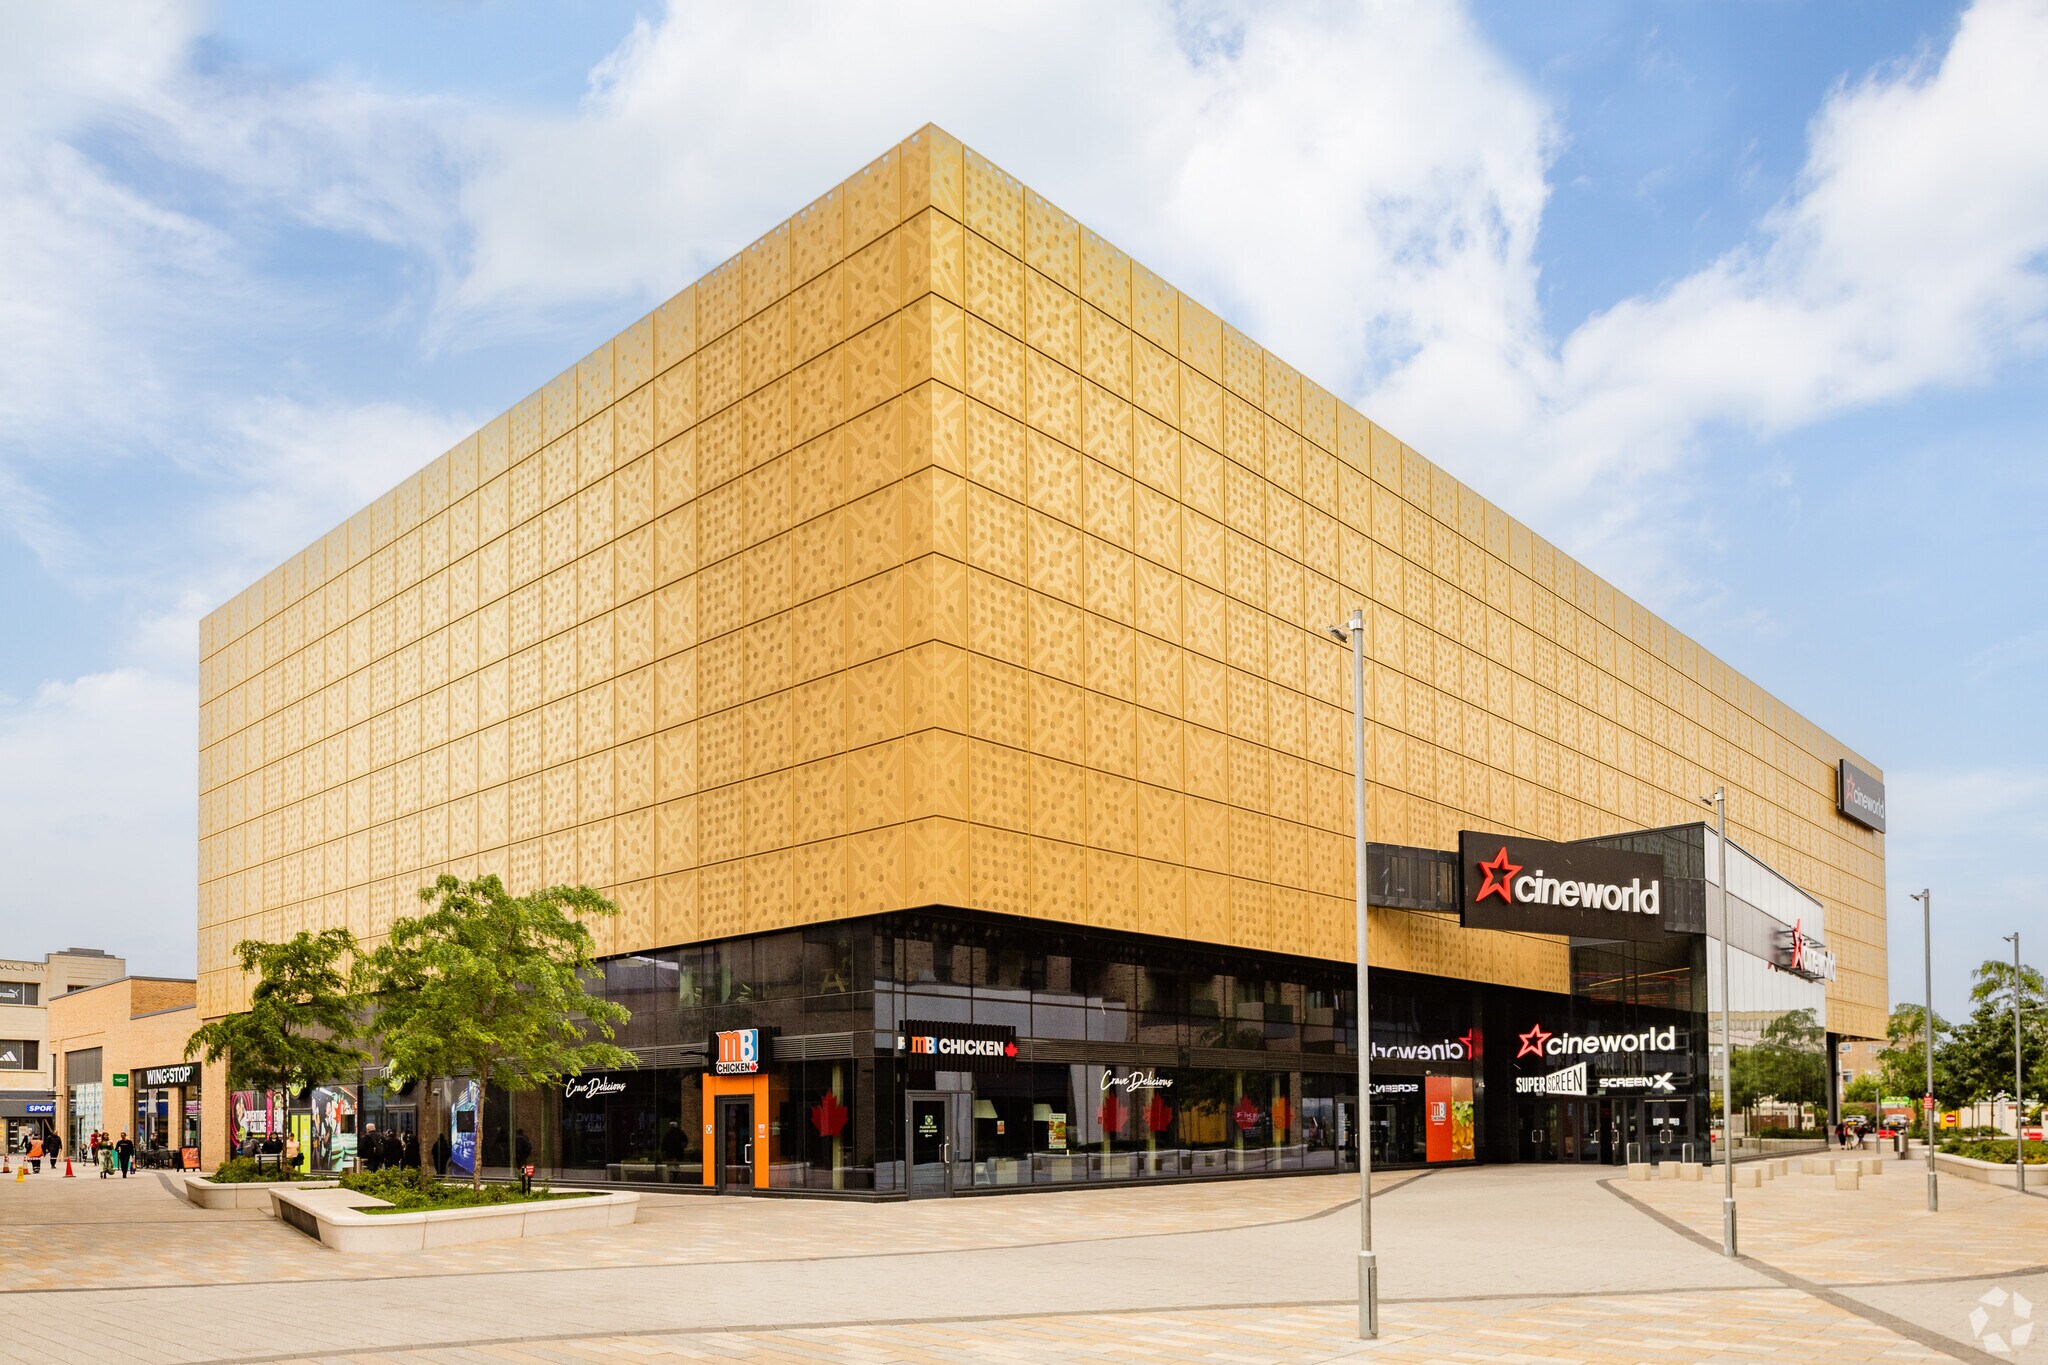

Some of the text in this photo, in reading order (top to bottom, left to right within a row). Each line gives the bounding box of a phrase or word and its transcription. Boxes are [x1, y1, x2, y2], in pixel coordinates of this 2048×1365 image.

[1853, 786, 1884, 819] cineworld
[1514, 869, 1660, 915] cineworld
[939, 1038, 1004, 1056] CHICKEN
[1546, 1025, 1676, 1056] cineworld
[717, 1063, 750, 1074] CHICKEN
[565, 1076, 627, 1099] Crave Delicious
[1100, 1069, 1174, 1093] Crave Delicious
